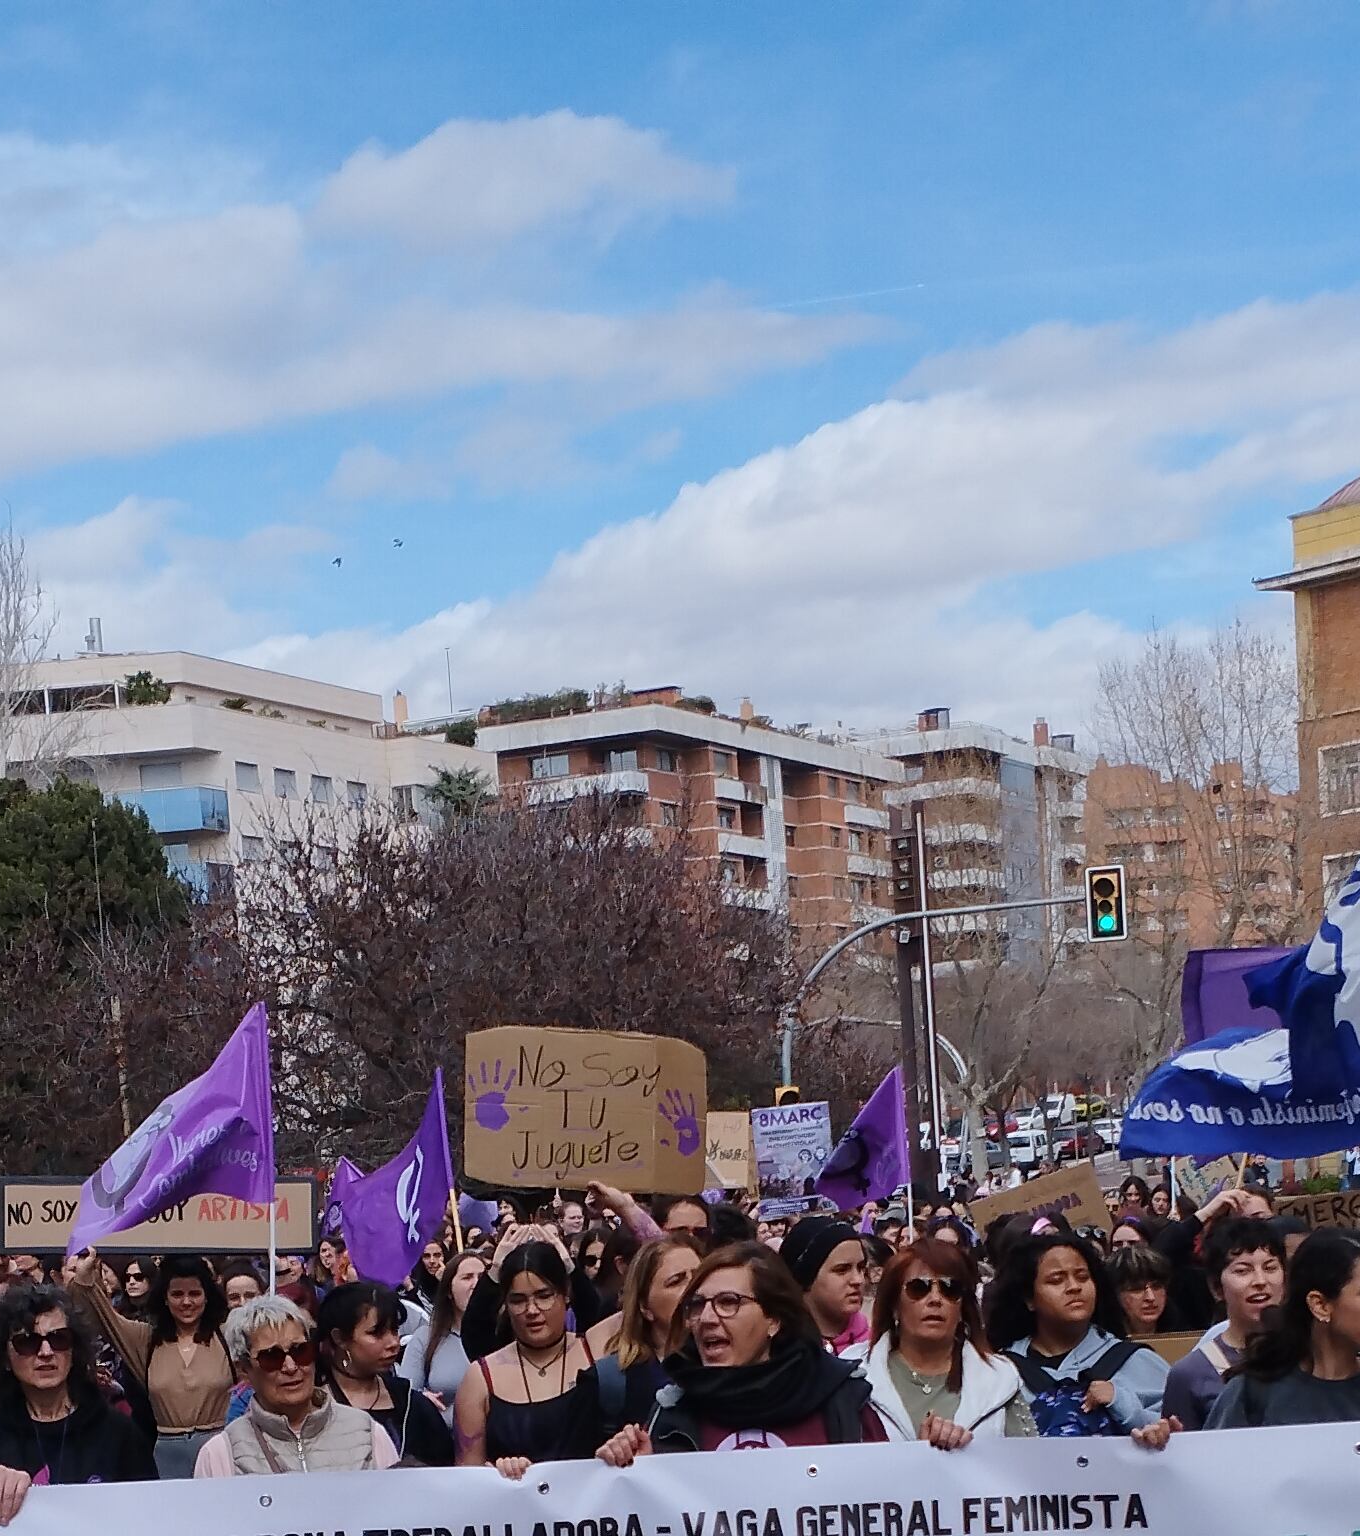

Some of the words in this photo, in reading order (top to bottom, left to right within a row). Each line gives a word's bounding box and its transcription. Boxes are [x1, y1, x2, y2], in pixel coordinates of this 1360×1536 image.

[519, 1045, 571, 1088] No
[582, 1052, 661, 1097] Soy
[512, 1130, 639, 1180] Juguete
[7, 1202, 33, 1227] NO
[40, 1200, 78, 1223] SOY
[148, 1198, 190, 1223] OY
[962, 1493, 1150, 1535] FEMINISTA
